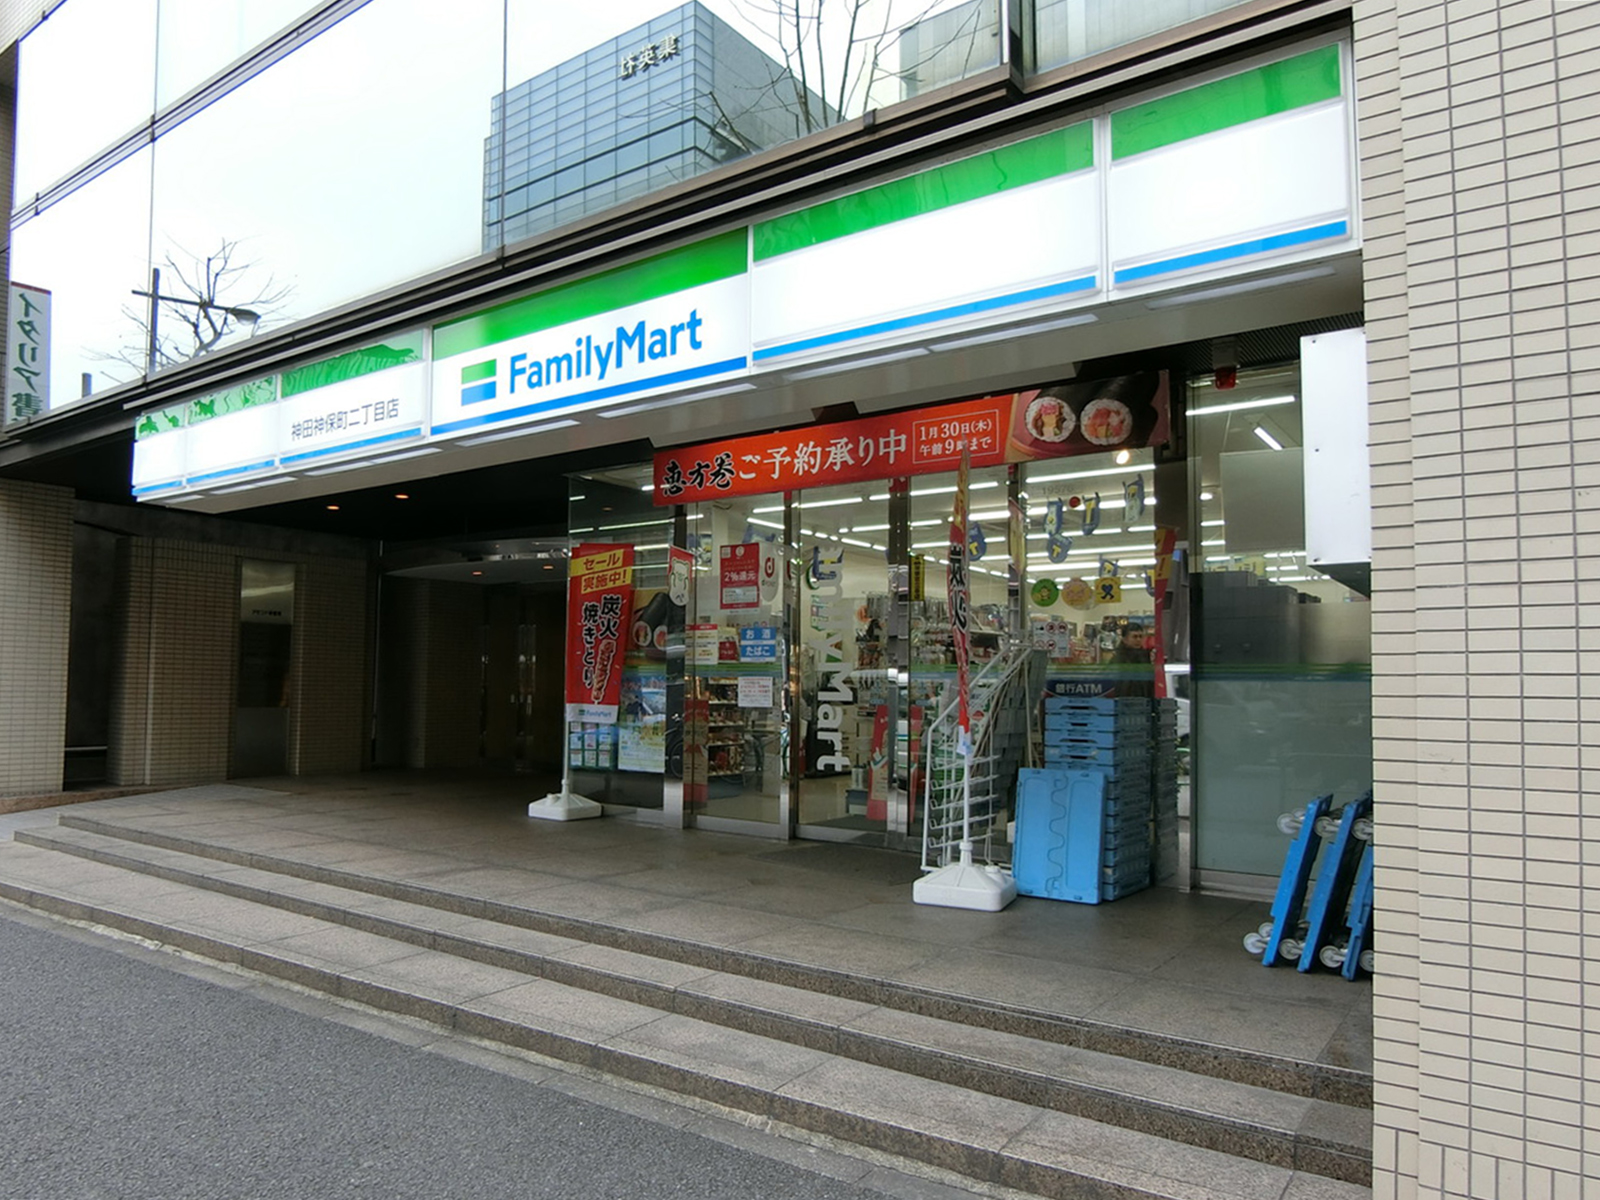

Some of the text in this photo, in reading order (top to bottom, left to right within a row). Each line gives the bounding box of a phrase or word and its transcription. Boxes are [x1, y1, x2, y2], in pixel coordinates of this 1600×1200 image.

[510, 308, 702, 394] FamilyMart
[291, 398, 399, 441] 神田神保町二丁目店
[920, 418, 992, 441] 1月30日(木)
[583, 553, 620, 571] セール
[583, 569, 627, 591] 実施中!
[599, 595, 621, 639] 炭火
[582, 602, 600, 688] 焼きとり
[745, 646, 771, 656] たばこ
[809, 540, 853, 771] amilyMart
